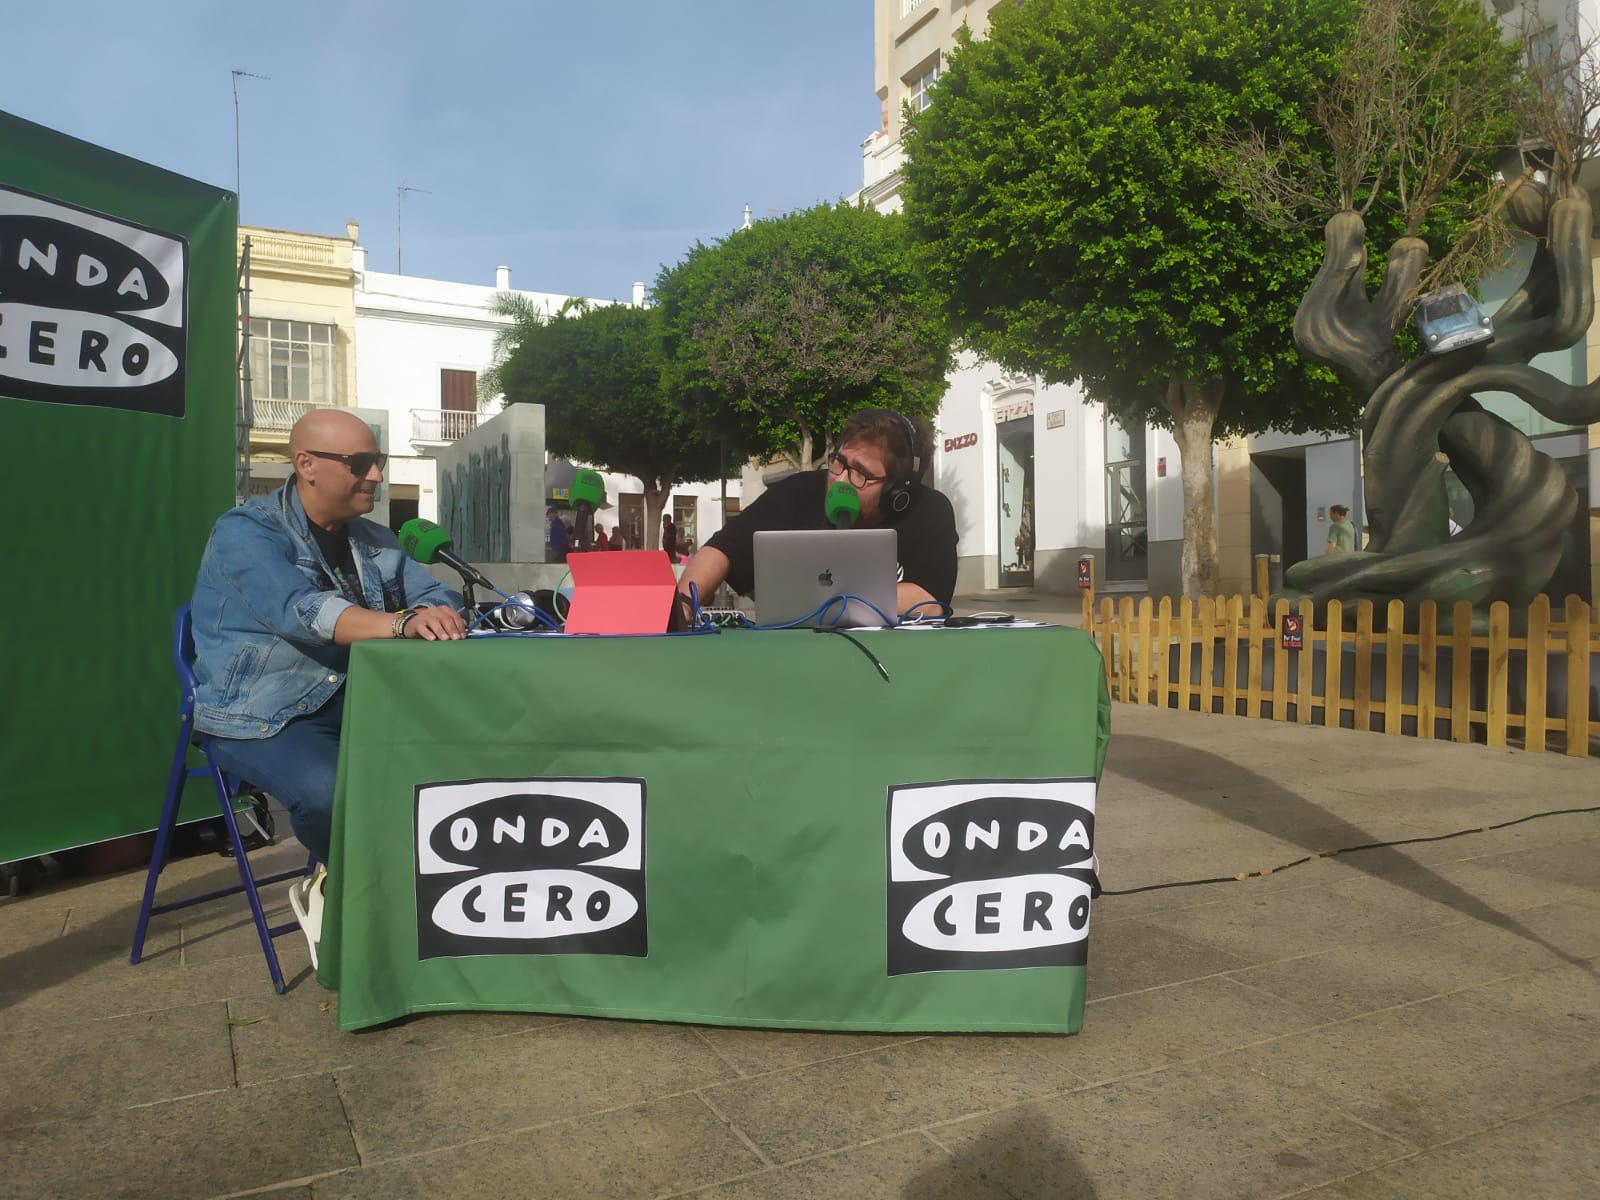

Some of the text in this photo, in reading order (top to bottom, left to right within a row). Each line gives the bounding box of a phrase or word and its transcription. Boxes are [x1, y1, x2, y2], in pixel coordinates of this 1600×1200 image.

[450, 815, 610, 852] ONDA
[923, 819, 1091, 858] ONDA
[461, 883, 611, 923] CERO
[933, 891, 1090, 936] CERO
